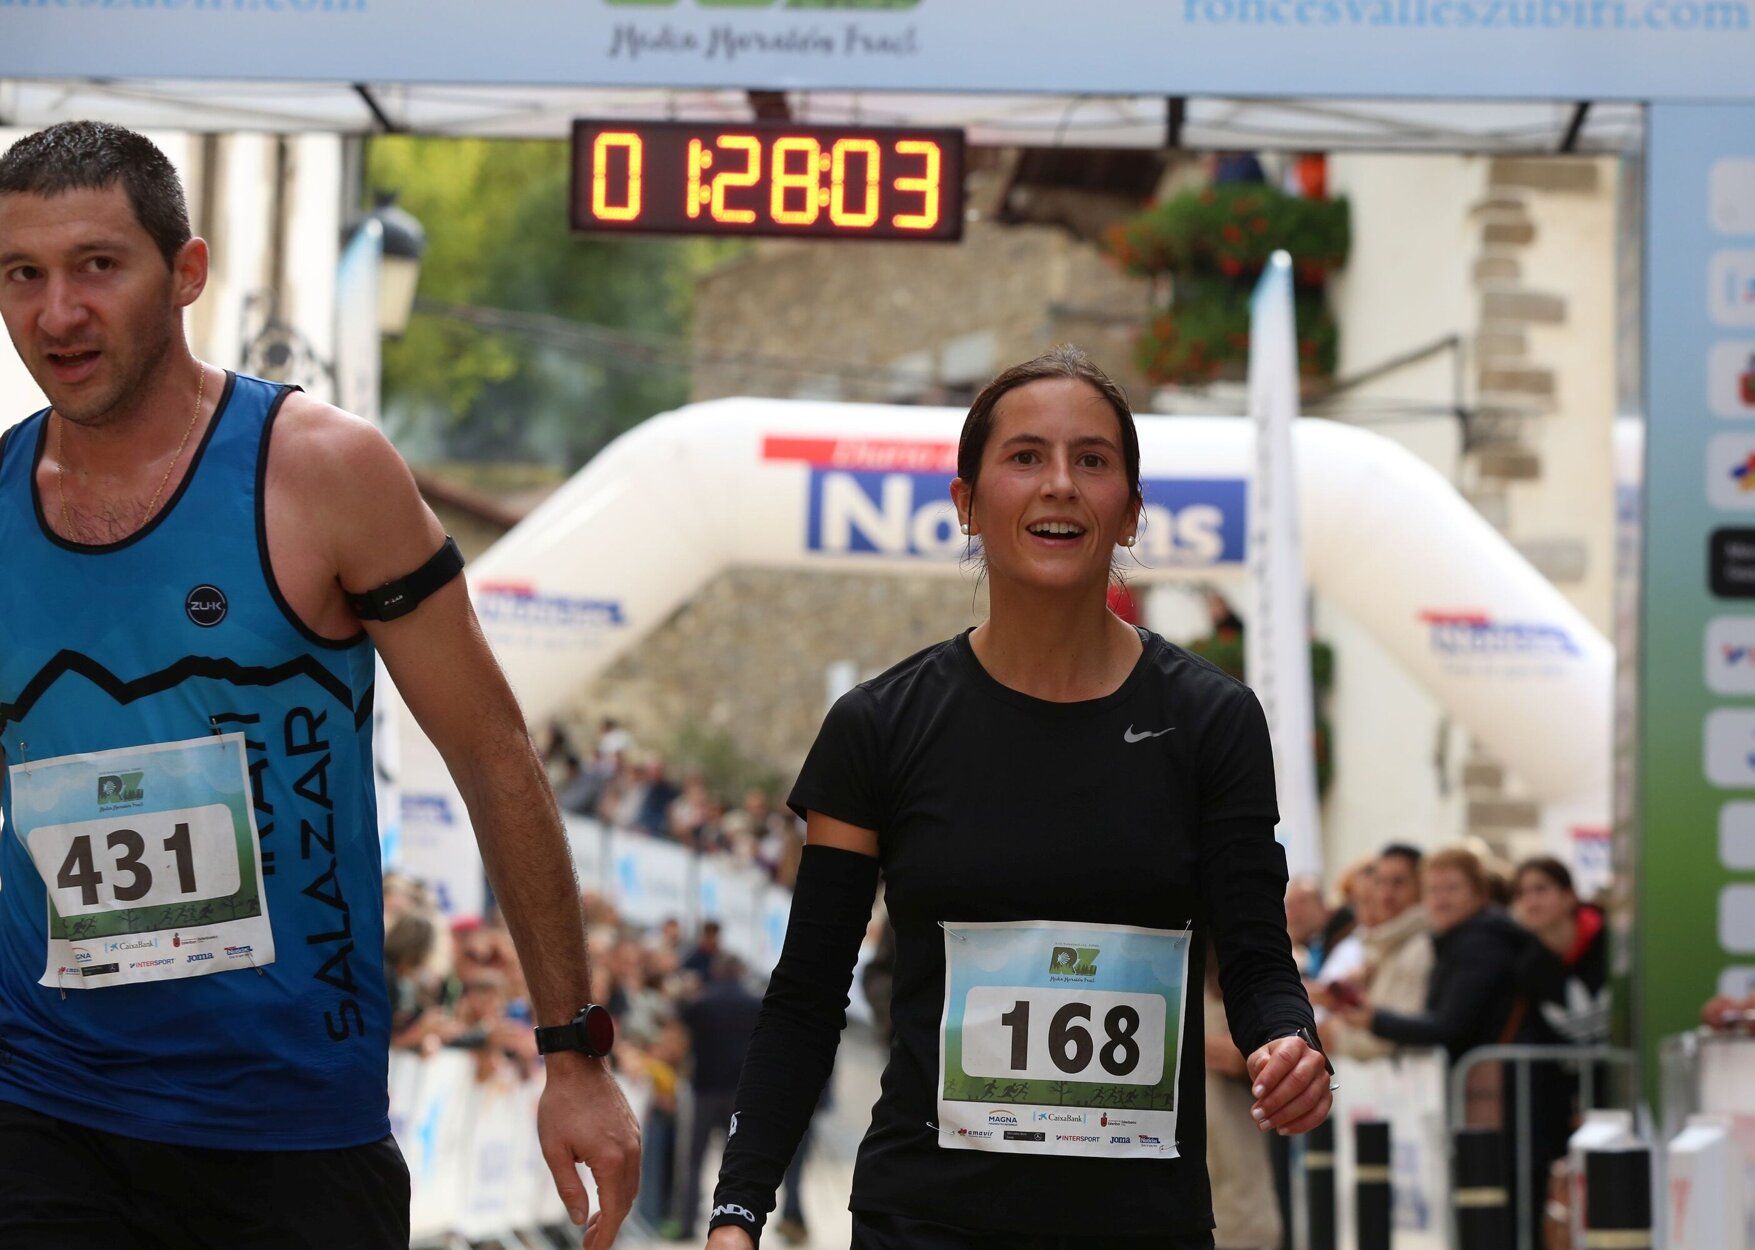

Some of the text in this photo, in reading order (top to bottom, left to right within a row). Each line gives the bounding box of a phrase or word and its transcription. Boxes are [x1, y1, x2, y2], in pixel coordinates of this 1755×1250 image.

[590, 131, 643, 221] 0
[57, 822, 198, 906] 431
[283, 706, 365, 1042] SALAZAR
[135, 957, 175, 969] INTERSPORT
[1001, 1000, 1140, 1076] 168
[988, 1113, 1083, 1124] MAGNA CaixaBank
[1061, 1135, 1100, 1143] INTERSPORT
